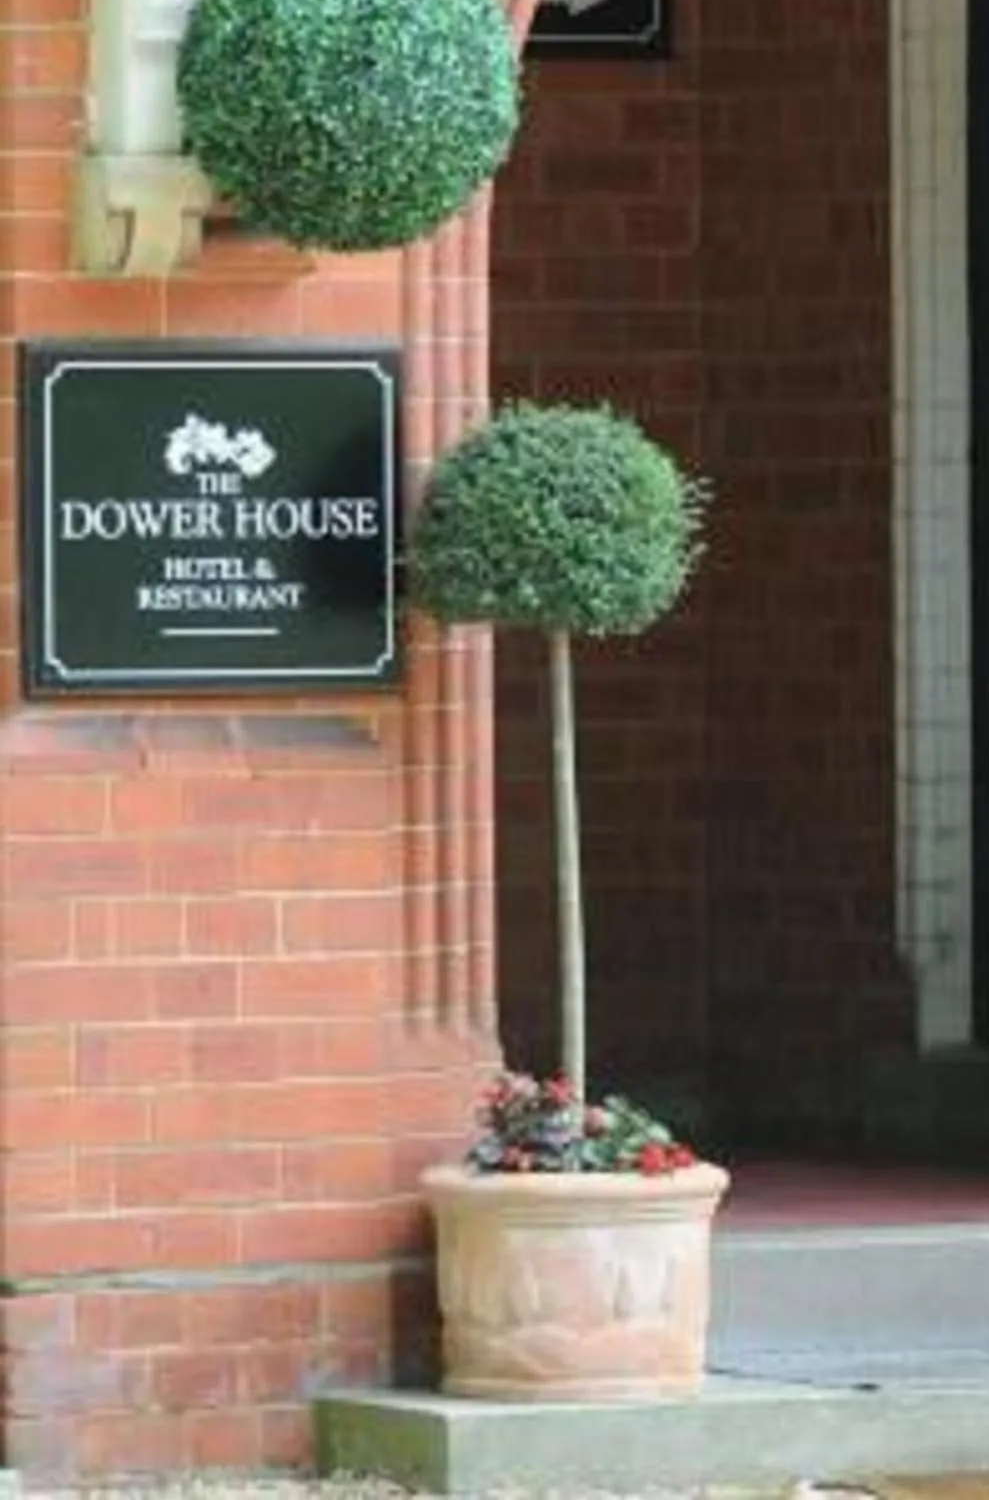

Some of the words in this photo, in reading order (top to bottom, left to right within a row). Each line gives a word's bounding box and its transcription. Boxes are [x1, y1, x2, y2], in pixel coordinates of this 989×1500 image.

[197, 472, 242, 495] THE
[61, 500, 222, 540] DOWER
[235, 499, 379, 538] HOUSE
[164, 558, 247, 580] HOTEL
[254, 558, 276, 580] &
[137, 584, 303, 610] RESTAURANT
